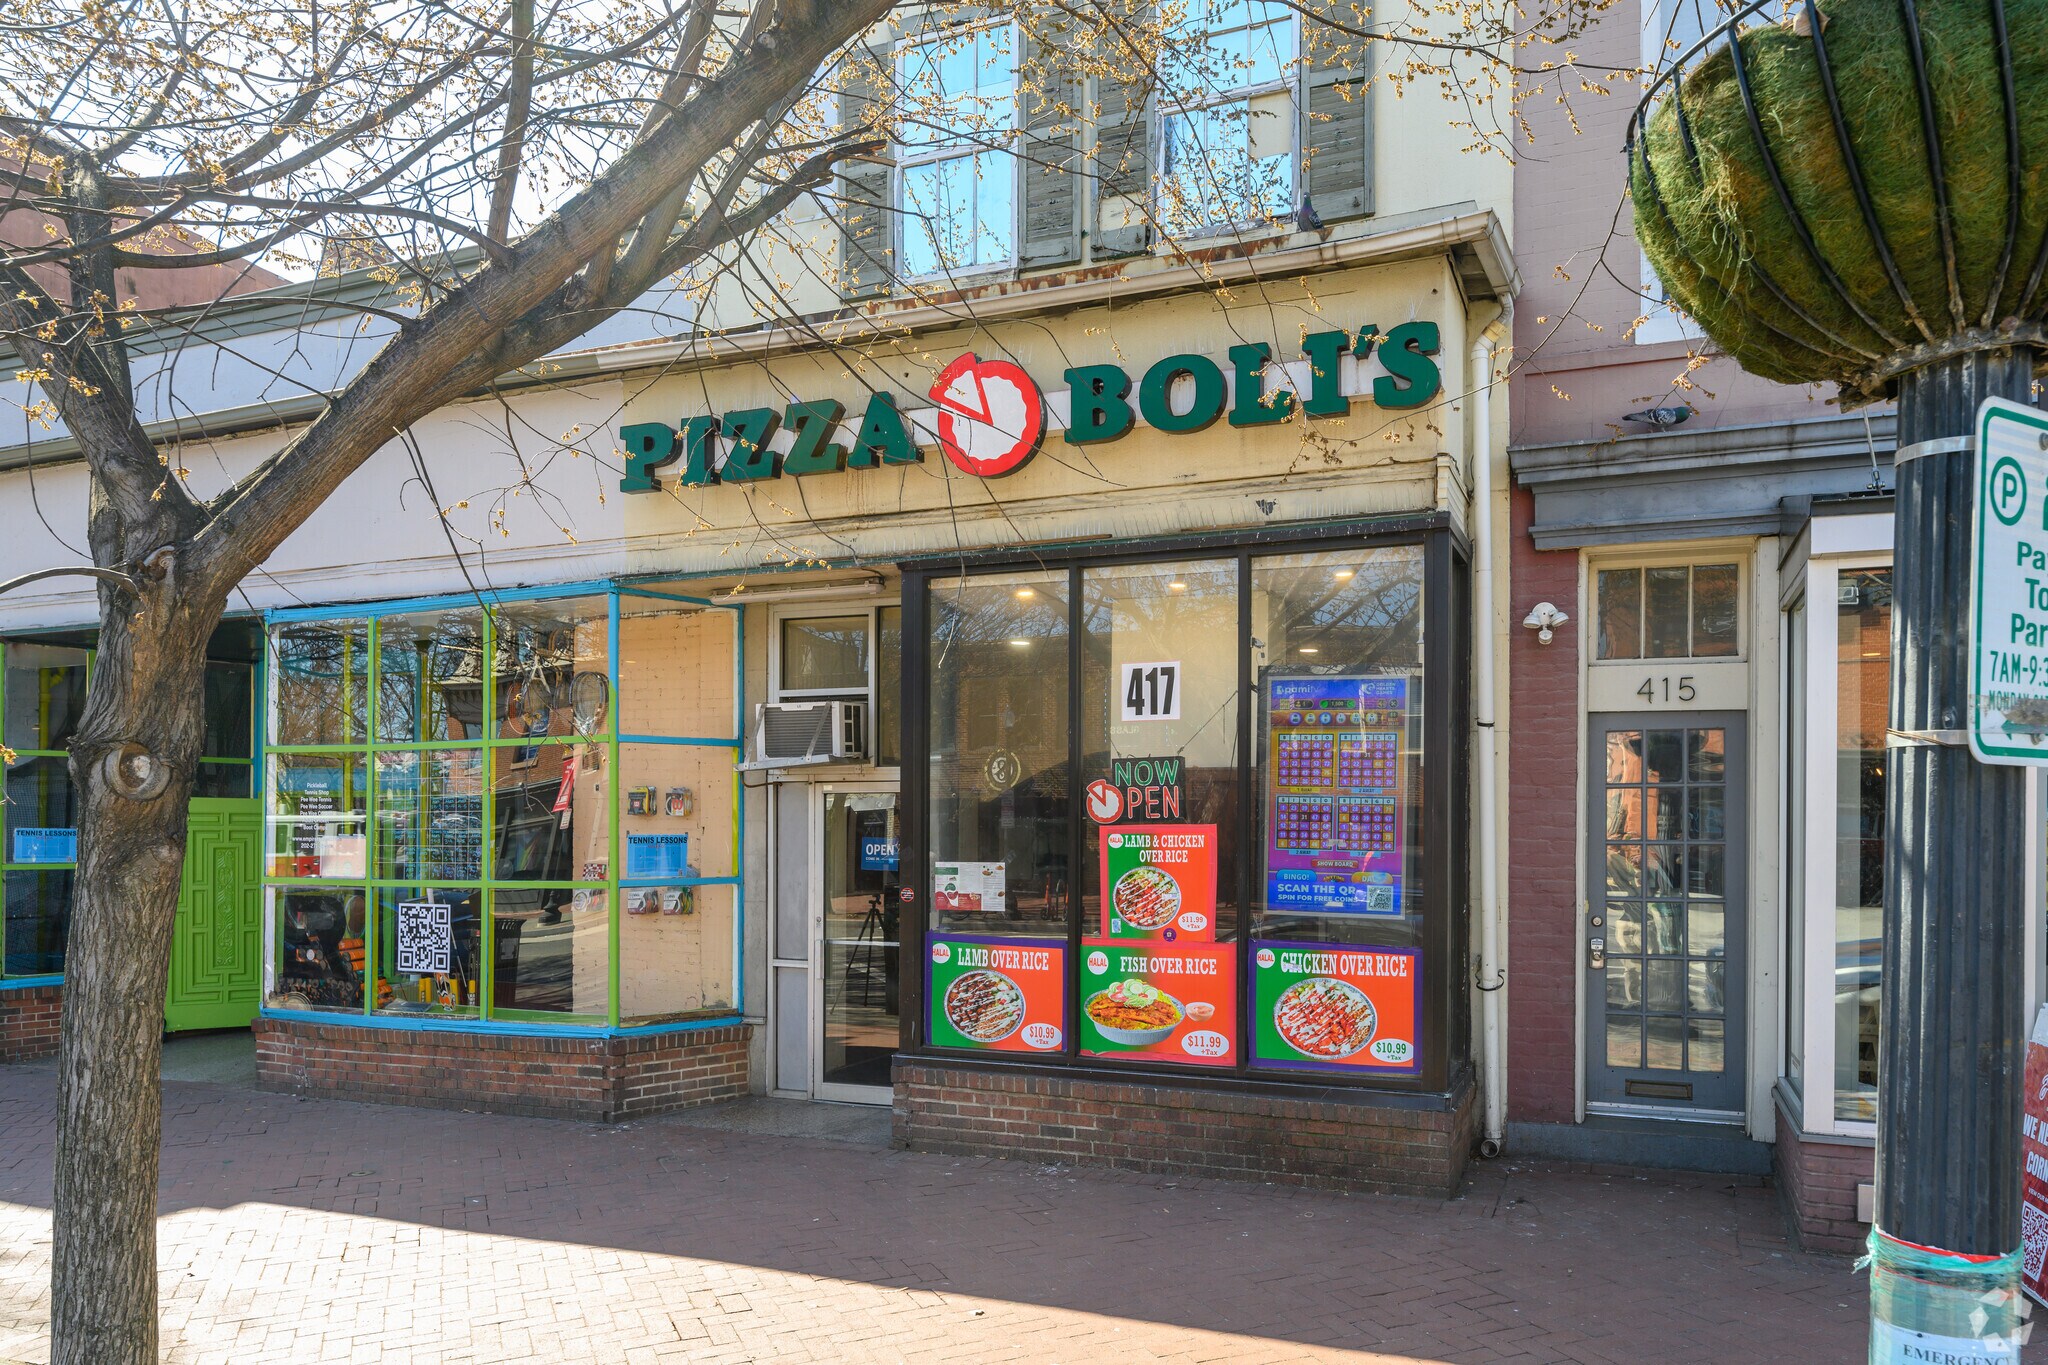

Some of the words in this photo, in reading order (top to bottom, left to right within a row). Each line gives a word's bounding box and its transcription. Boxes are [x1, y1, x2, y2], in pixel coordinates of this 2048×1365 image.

[619, 390, 925, 495] PIZZA
[1063, 320, 1444, 445] BOLI'S
[2017, 541, 2048, 571] Pa
[2025, 577, 2048, 611] To
[1126, 666, 1175, 716] 417
[1637, 676, 1696, 704] 415
[1114, 760, 1179, 787] NOW
[866, 844, 894, 856] OPEN
[1124, 835, 1151, 848] LAMB
[1153, 835, 1159, 848] &
[1161, 835, 1205, 848] CHICKEN
[1139, 850, 1165, 863] OVER
[1165, 850, 1188, 863] RICE
[1284, 873, 1310, 881] BINGO!
[1277, 884, 1309, 893] SCAN
[1312, 885, 1335, 894] THE
[1339, 886, 1356, 896] QR
[1182, 916, 1204, 924] $11.99
[932, 948, 950, 957] HALAL
[958, 948, 989, 967] LAMB
[991, 949, 1021, 969] OVER
[1022, 951, 1049, 971] RICE
[1088, 957, 1107, 967] HALAL
[1120, 956, 1148, 973] FISH
[1150, 957, 1184, 974] OVER
[1185, 958, 1217, 975] RICE
[1257, 954, 1274, 962] HALAL
[1280, 952, 1338, 975] CHICKEN
[1340, 954, 1374, 976] OVER
[1376, 956, 1407, 977] RICE
[1030, 1026, 1055, 1039] $10.99
[1188, 1036, 1221, 1048] $11.99
[1376, 1042, 1407, 1055] $10.99
[2023, 1113, 2038, 1140] WE
